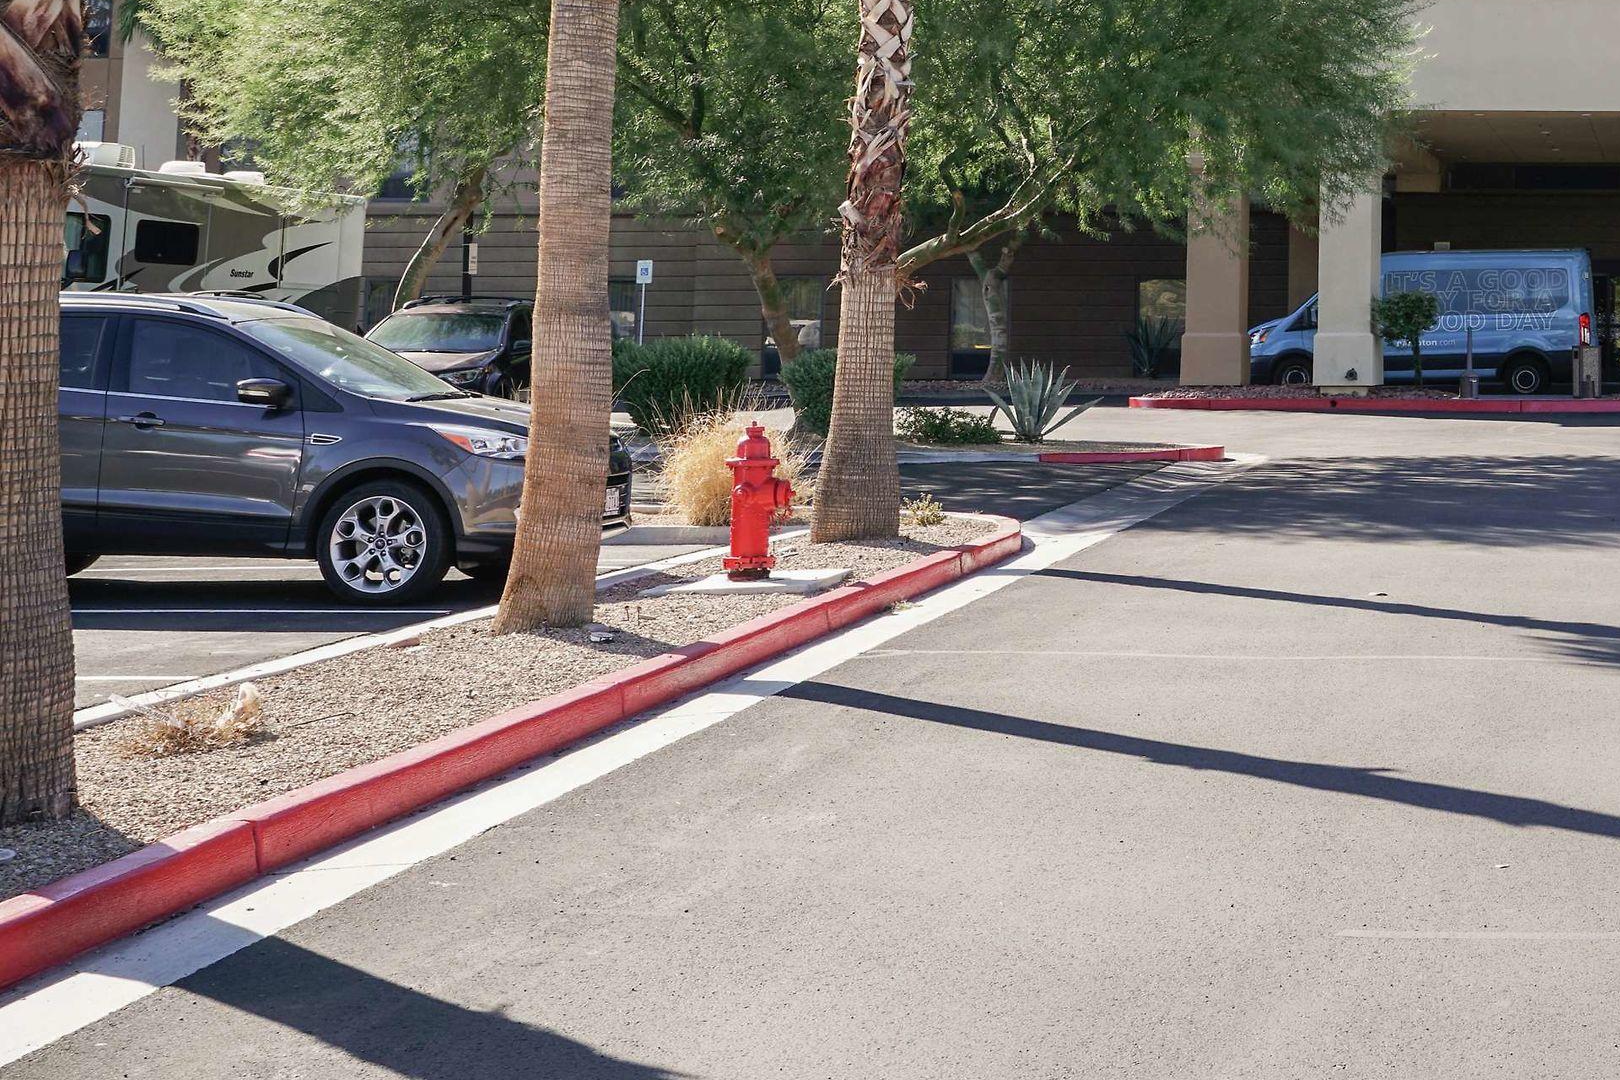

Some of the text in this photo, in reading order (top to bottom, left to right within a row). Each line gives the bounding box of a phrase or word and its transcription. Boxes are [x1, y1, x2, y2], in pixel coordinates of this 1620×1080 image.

[229, 268, 254, 278] Sunstar
[1446, 271, 1468, 292] A
[1477, 269, 1567, 291] GOOD
[1469, 289, 1525, 312] FOR
[1534, 289, 1558, 312] A
[1495, 309, 1558, 332] DAY
